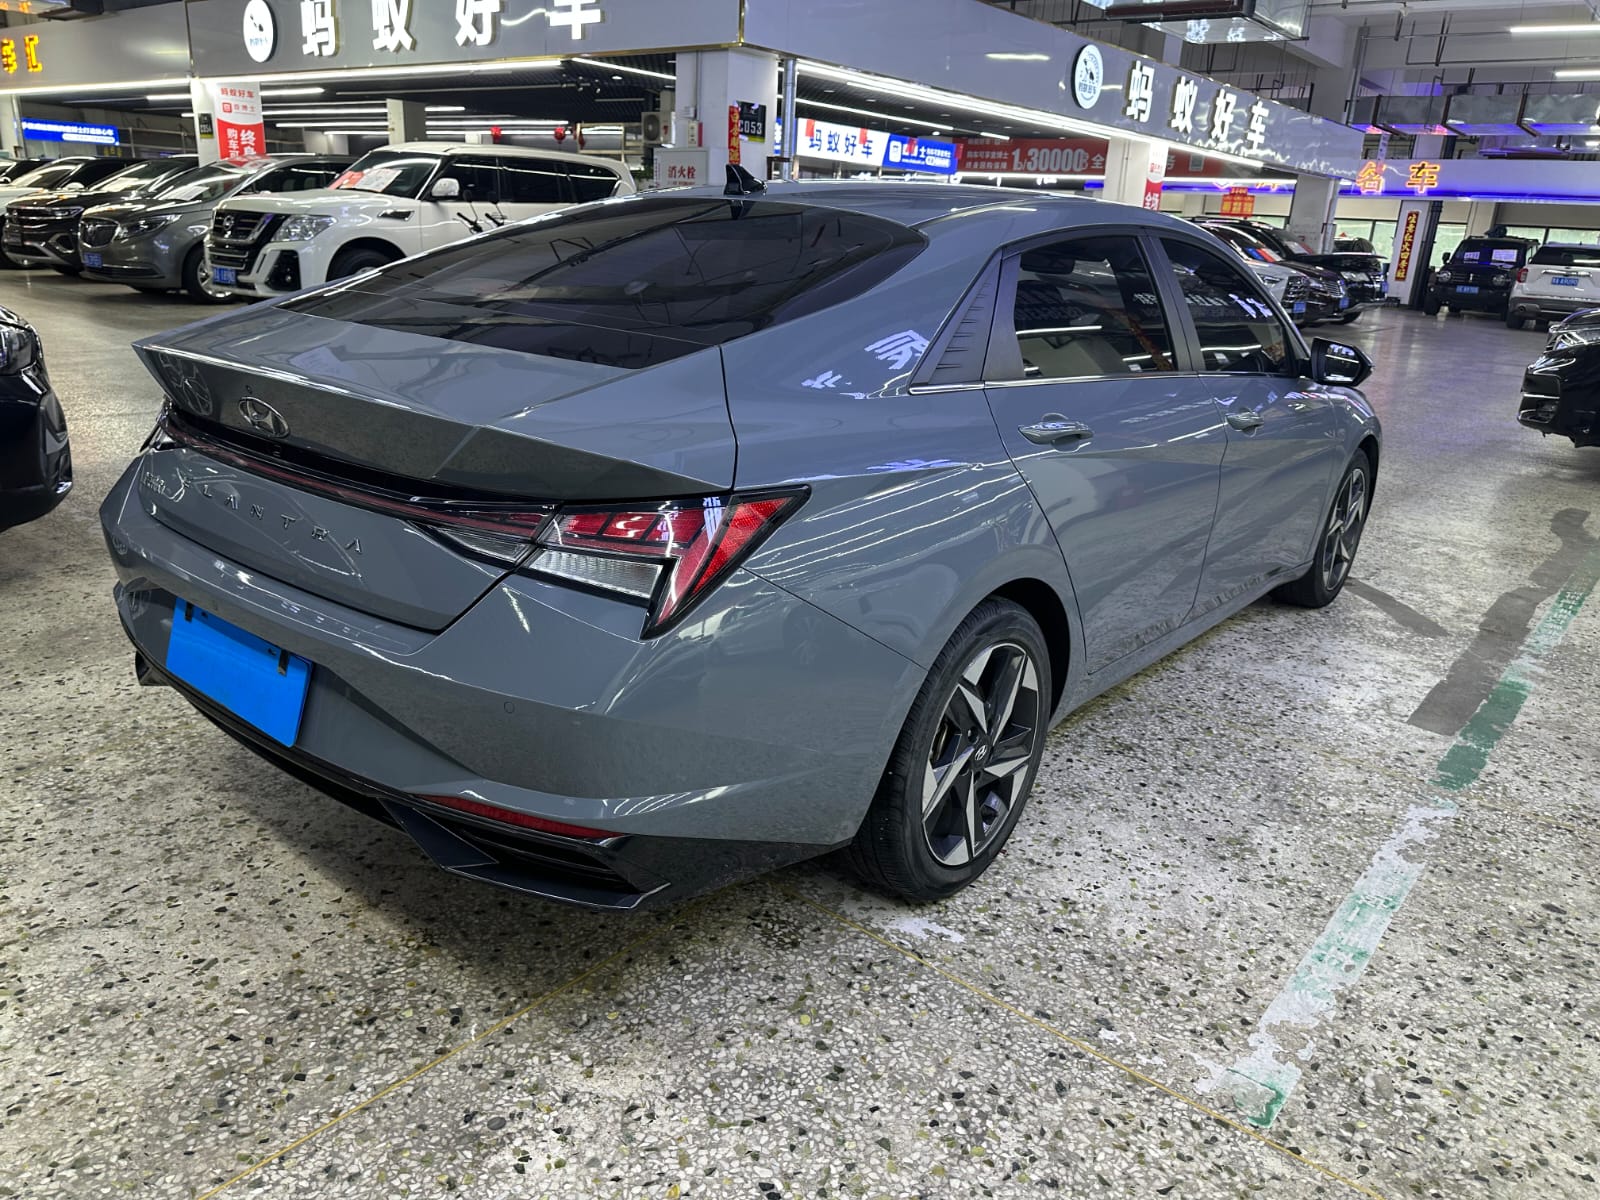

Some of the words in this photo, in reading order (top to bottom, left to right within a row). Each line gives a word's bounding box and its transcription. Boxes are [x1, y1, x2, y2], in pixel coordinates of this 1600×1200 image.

[1126, 60, 1270, 150] 蚂蚁好车
[809, 129, 874, 159] 蚂蚁好车
[668, 165, 697, 179] 消火栓
[184, 475, 362, 553] ELANTRA
